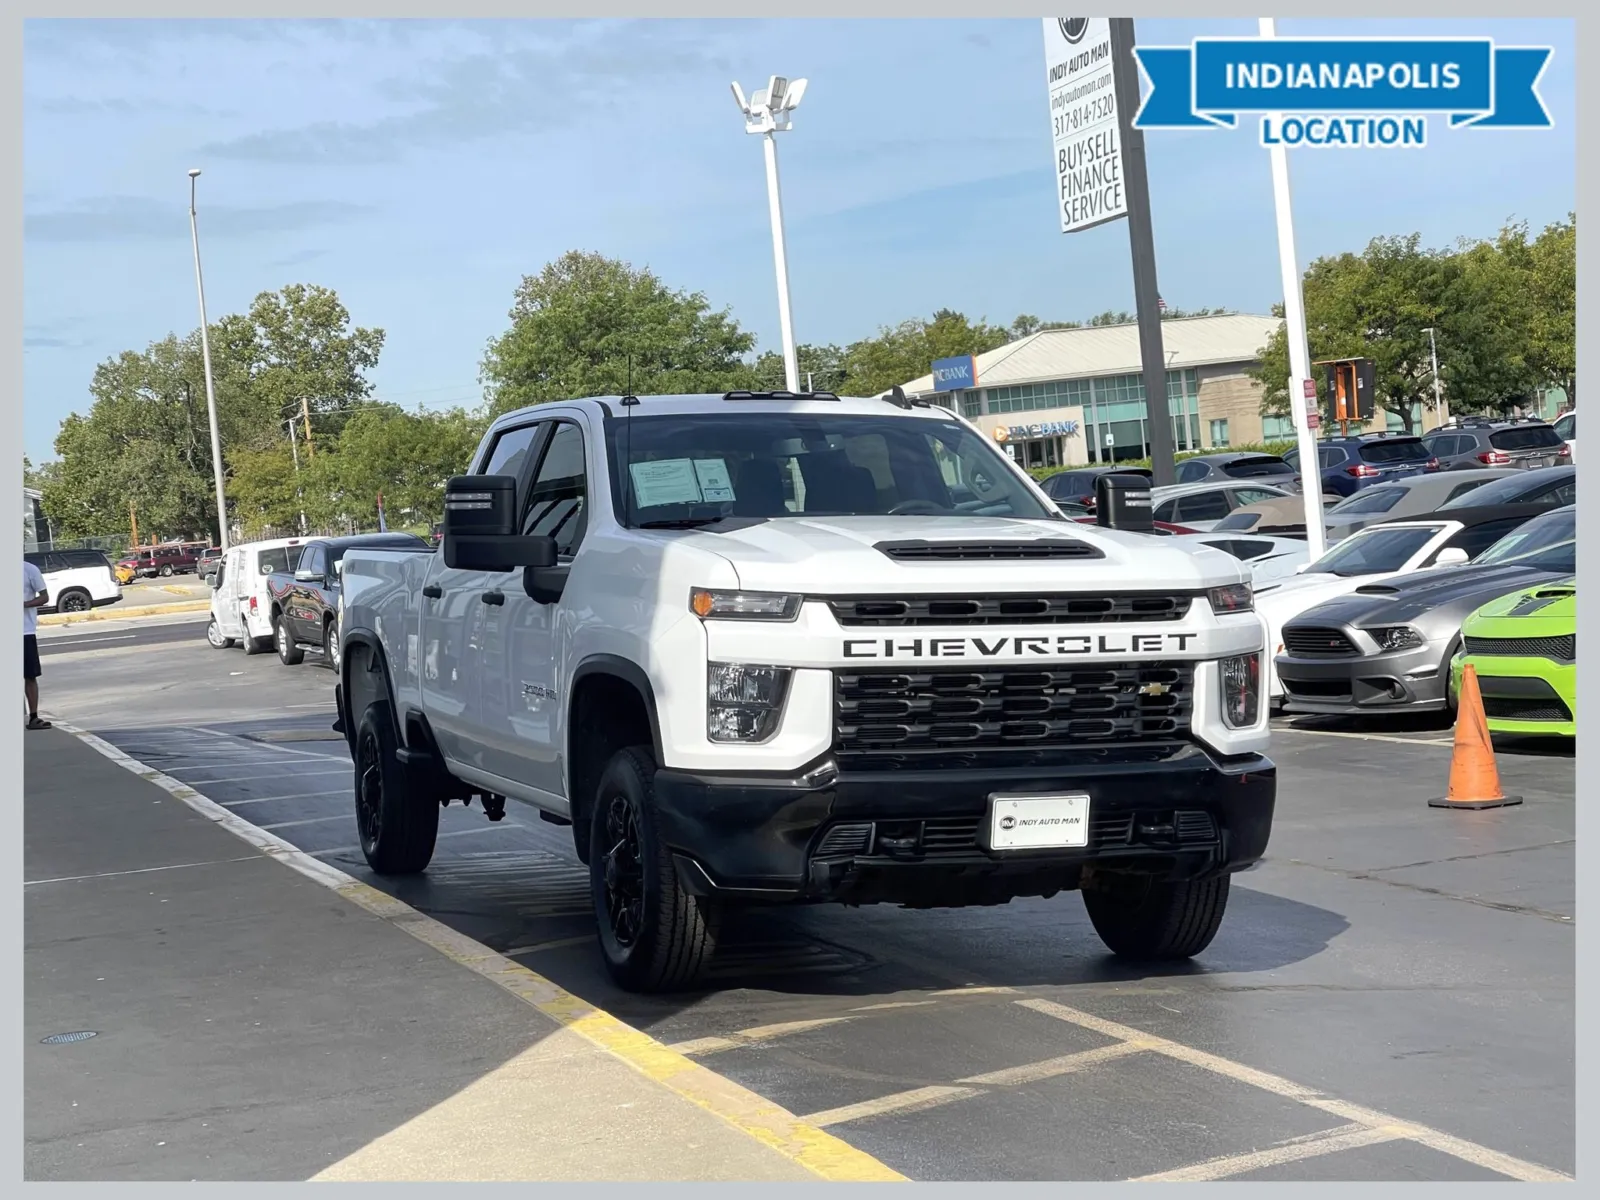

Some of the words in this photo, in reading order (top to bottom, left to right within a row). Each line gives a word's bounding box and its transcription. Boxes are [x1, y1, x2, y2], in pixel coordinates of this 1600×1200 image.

[1049, 61, 1068, 84] INDY
[1068, 50, 1090, 75] AUTO
[1090, 40, 1109, 64] MAN
[1051, 72, 1112, 111] indyautoman.com
[1061, 155, 1119, 200] FINANCE
[1063, 182, 1122, 226] SERVICE
[1041, 420, 1078, 436] BANK
[842, 633, 1198, 658] CHEVROLET
[1038, 818, 1060, 826] AUTO
[1061, 817, 1080, 825] MAN
